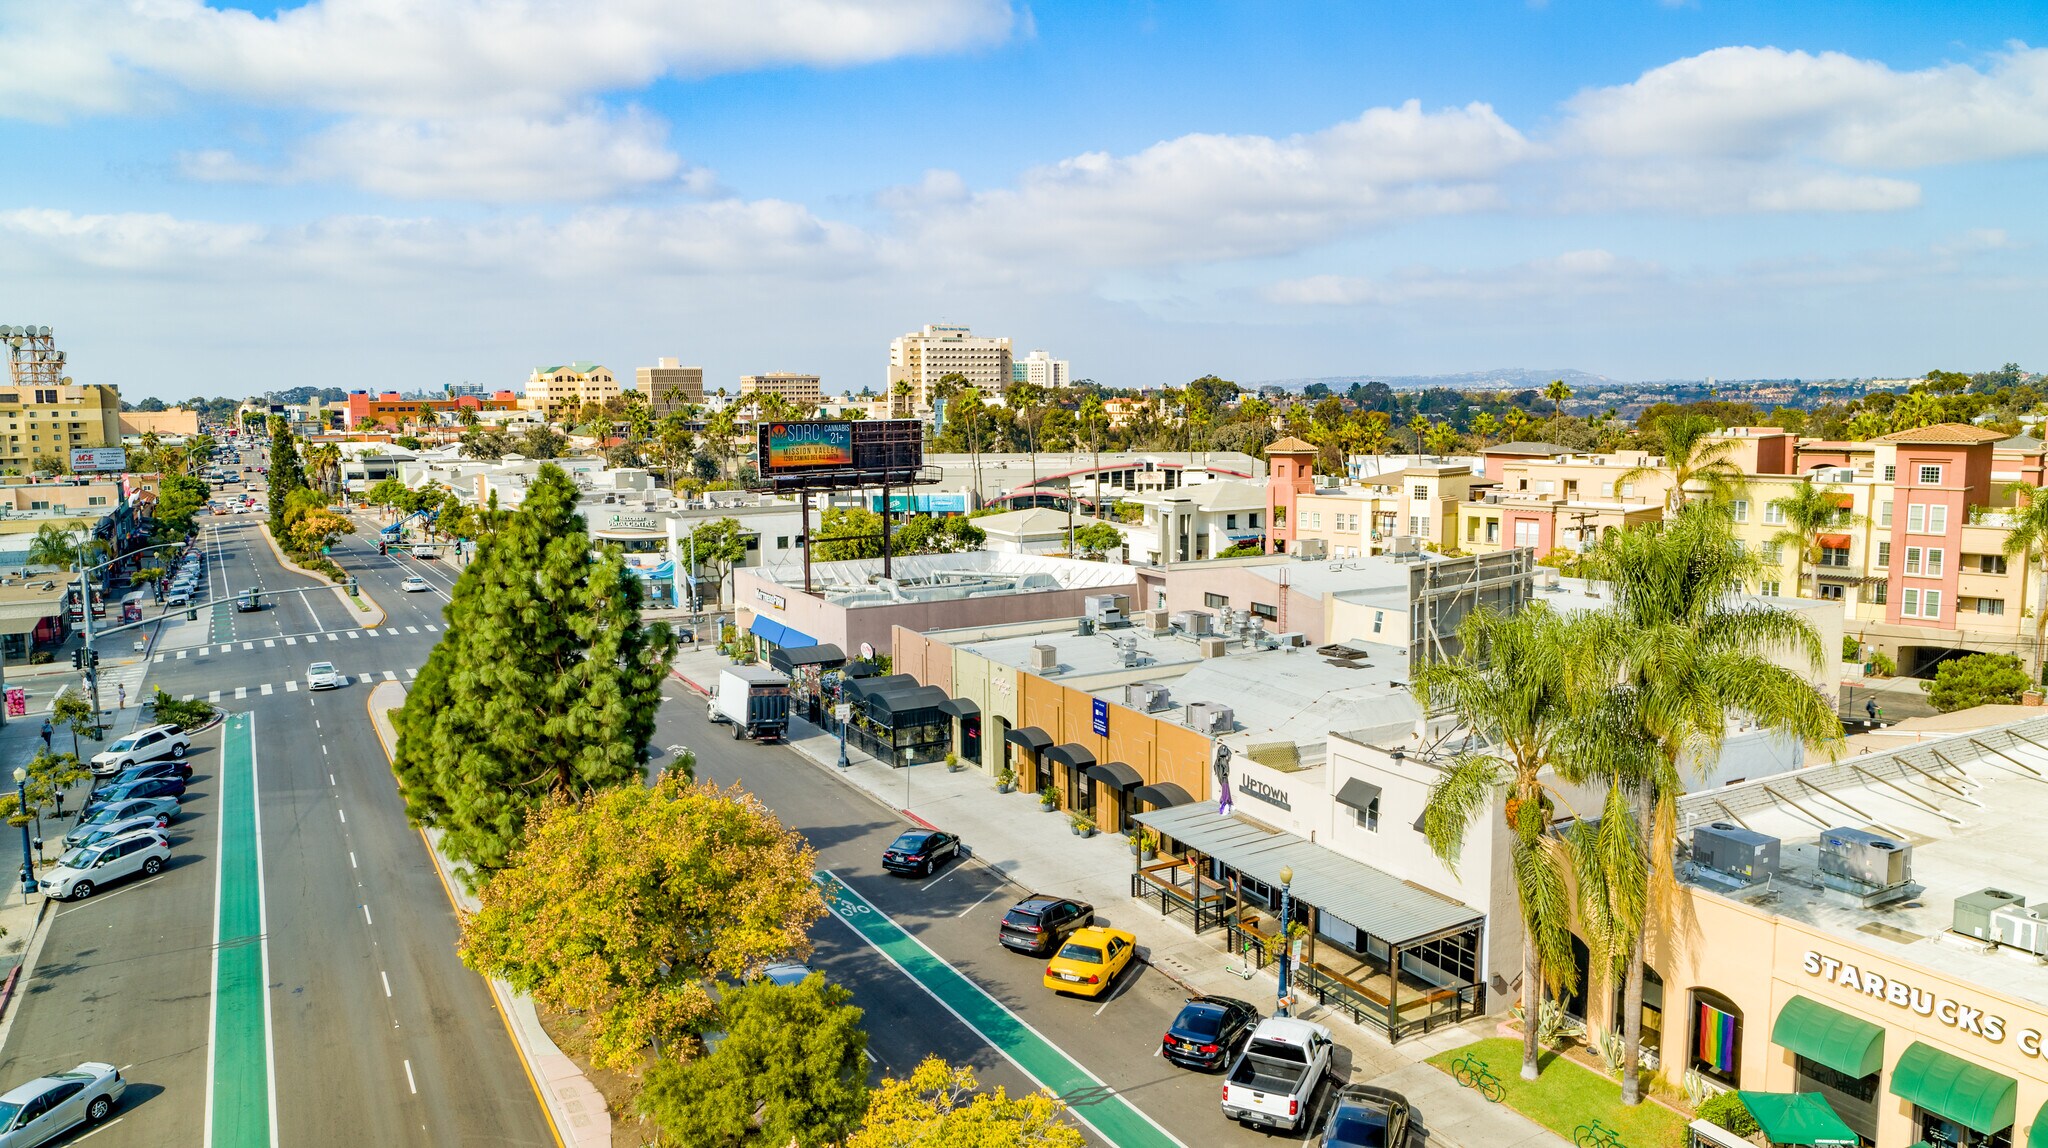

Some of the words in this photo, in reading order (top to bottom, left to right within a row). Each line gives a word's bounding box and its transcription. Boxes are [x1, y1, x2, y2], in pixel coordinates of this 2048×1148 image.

[788, 424, 819, 441] SDRC
[830, 432, 844, 444] 21+
[783, 448, 811, 456] MISSION
[1242, 773, 1288, 804] UPTOWN
[1802, 950, 2006, 1044] STARBUCKS
